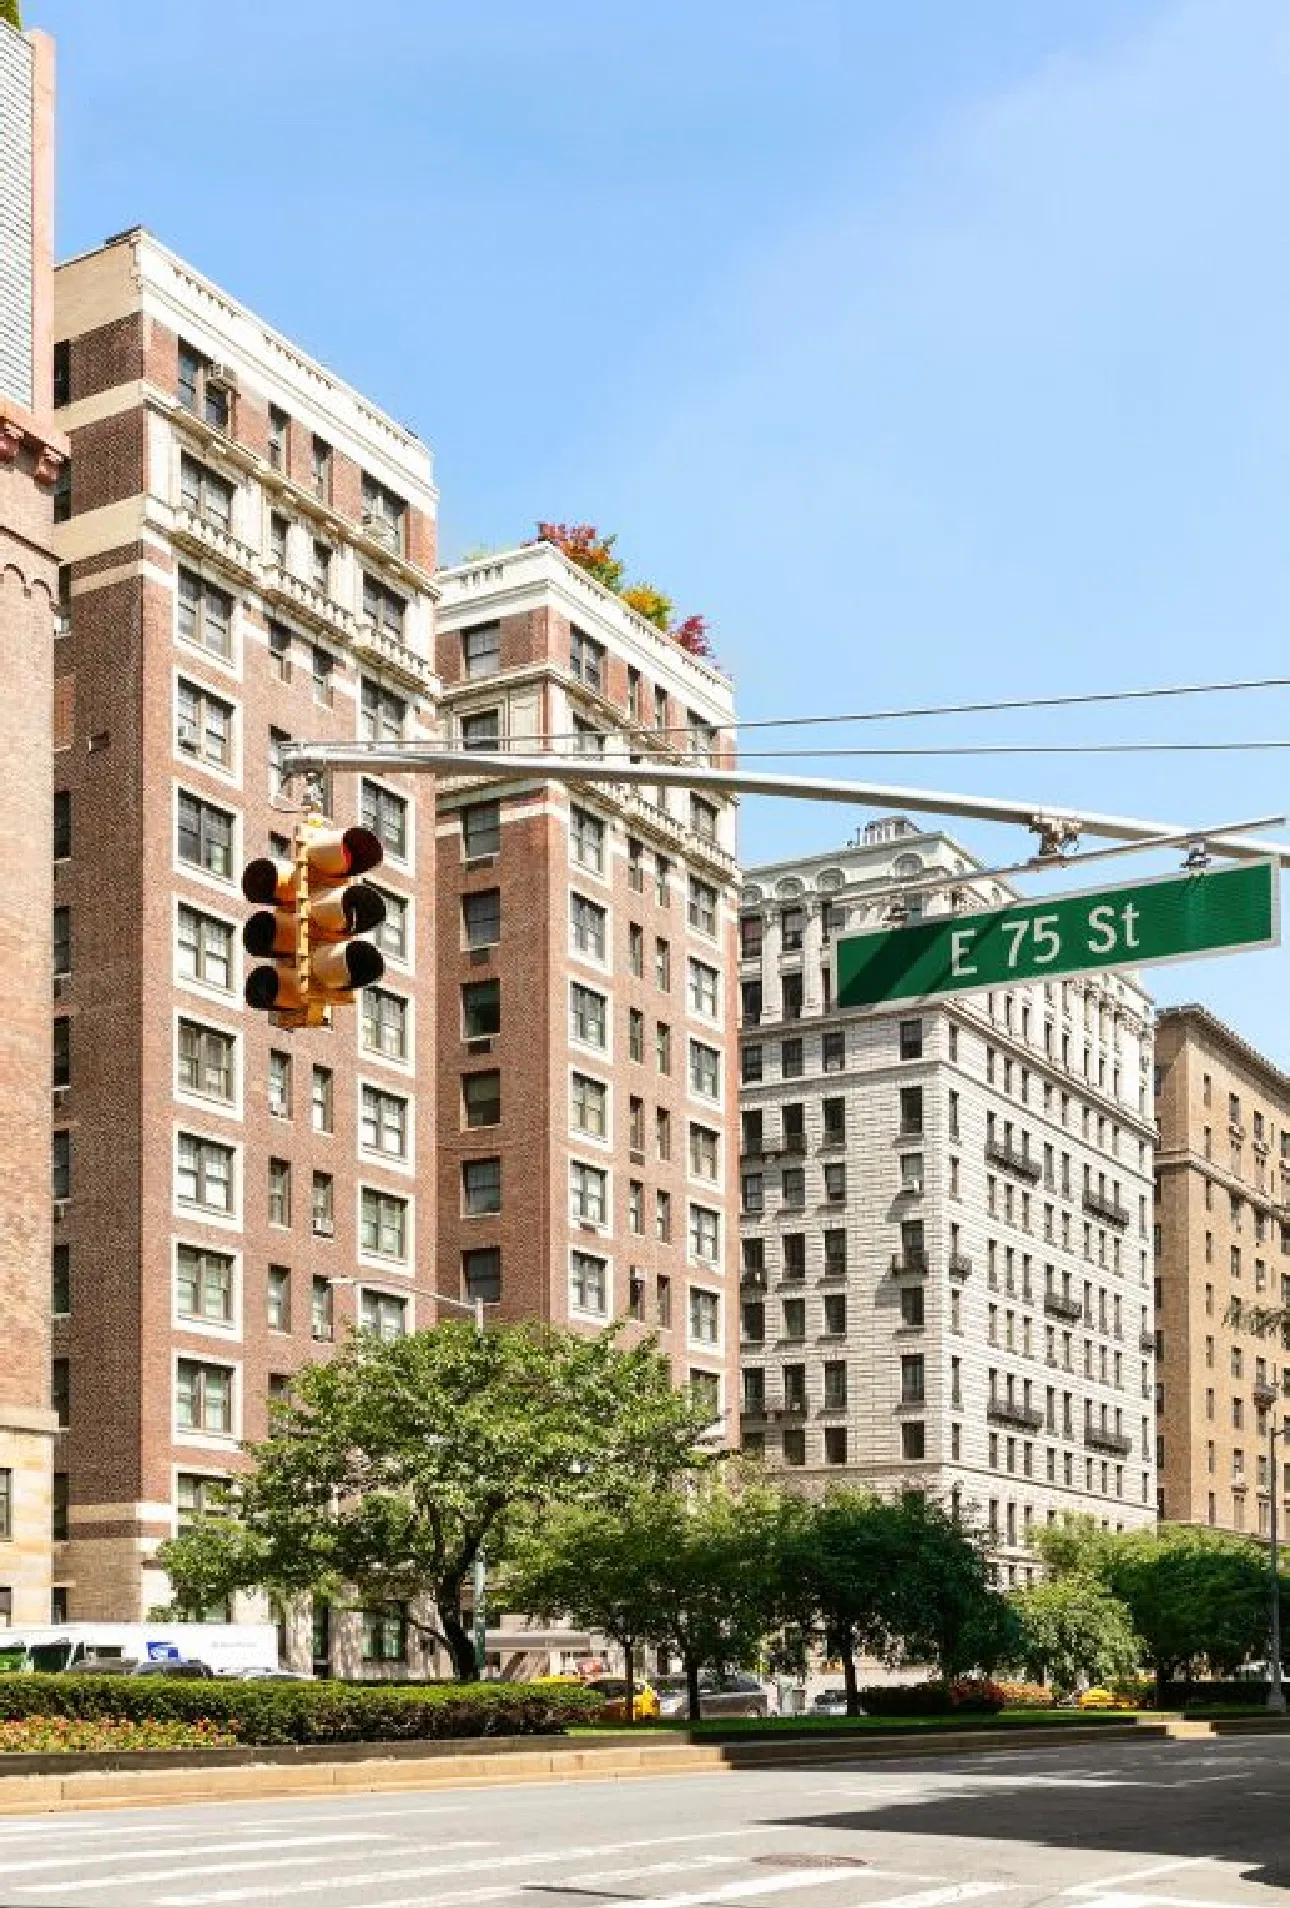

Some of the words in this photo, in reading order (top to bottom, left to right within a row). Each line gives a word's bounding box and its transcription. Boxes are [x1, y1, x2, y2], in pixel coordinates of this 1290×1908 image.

[951, 929, 978, 977] E
[1001, 915, 1061, 967] 75
[1088, 902, 1139, 953] St
